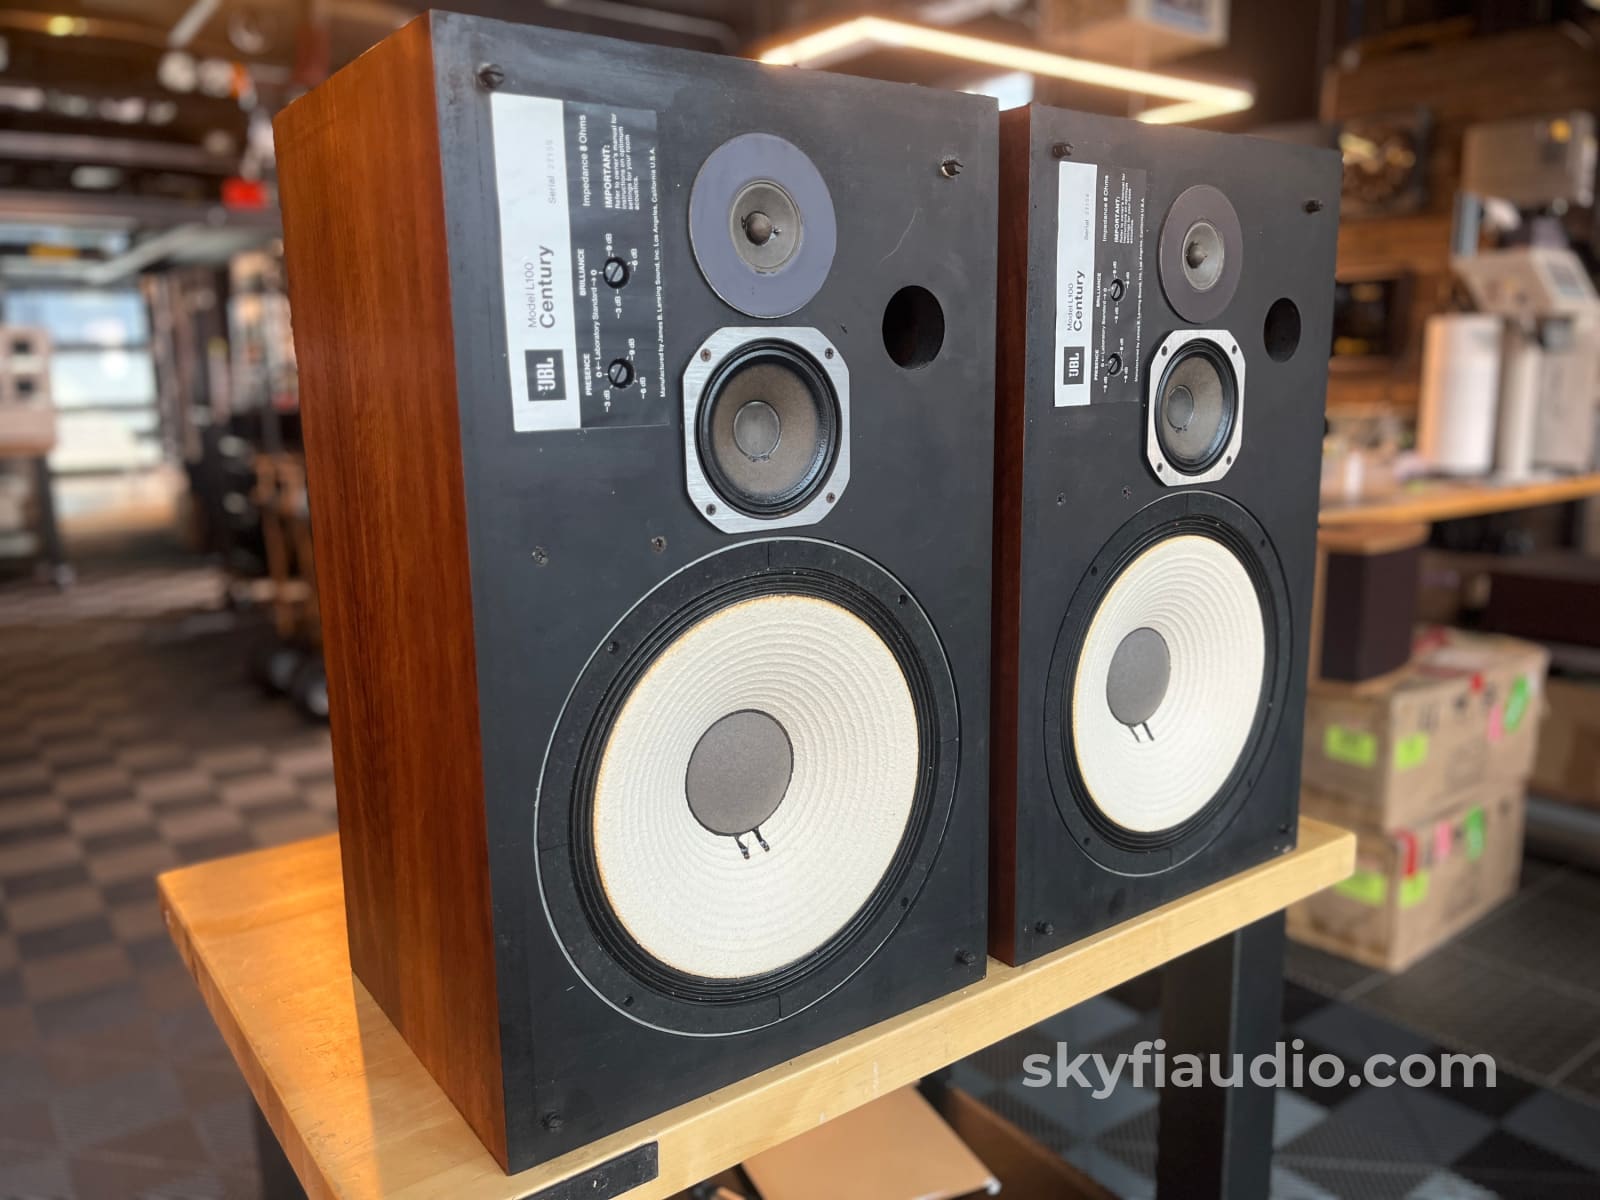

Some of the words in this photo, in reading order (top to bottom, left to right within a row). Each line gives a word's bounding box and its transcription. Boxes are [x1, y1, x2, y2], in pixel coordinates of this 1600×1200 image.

[579, 115, 587, 144] Ohms
[546, 176, 557, 204] Serial
[581, 154, 591, 207] Impedance
[602, 144, 613, 208] IMPORTANT:
[605, 233, 612, 244] dB
[631, 248, 638, 259] dB
[524, 262, 535, 290] L100
[538, 245, 555, 329] Century
[577, 248, 586, 296] BRILLIANCE
[526, 293, 537, 328] Model
[590, 287, 599, 320] Standard
[614, 296, 621, 307] dB
[1073, 270, 1085, 332] Century
[592, 321, 601, 360] Laboratory
[628, 338, 635, 349] dB
[536, 357, 556, 391] JBL
[583, 353, 592, 396] PRESENCE
[1068, 353, 1080, 378] JBL
[604, 390, 610, 401] dB
[640, 377, 646, 387] dB
